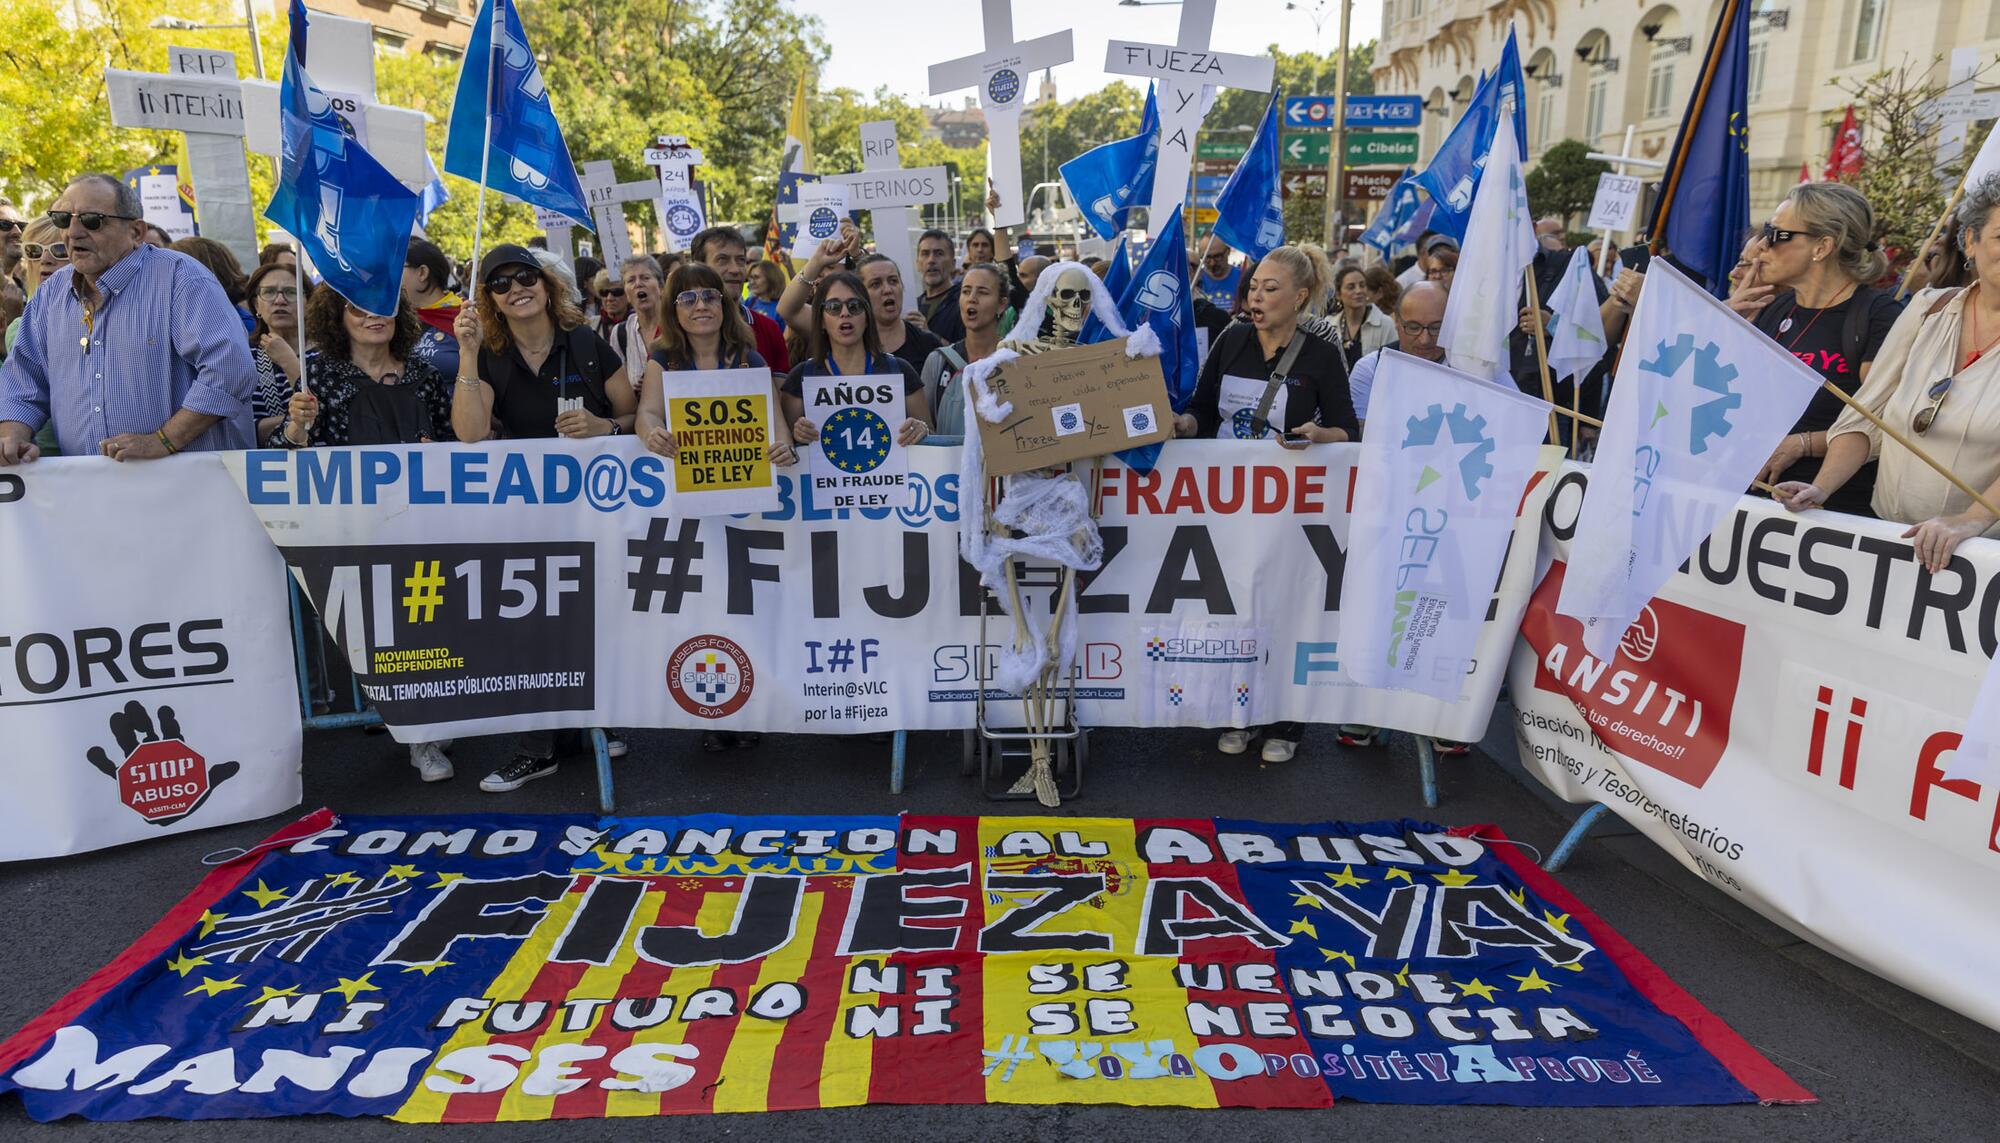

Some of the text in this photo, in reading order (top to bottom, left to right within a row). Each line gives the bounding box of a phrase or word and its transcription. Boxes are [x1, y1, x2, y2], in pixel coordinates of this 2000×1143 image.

[178, 54, 227, 75] RIP
[1124, 47, 1224, 75] FIJEZA
[650, 151, 692, 160] CESADA
[865, 139, 895, 158] RIP
[1350, 142, 1414, 154] de Cibeles
[665, 170, 684, 181] 24
[1350, 175, 1392, 186] Palacio
[850, 177, 936, 200] TERINOS
[814, 382, 894, 406] AÑOS
[684, 399, 758, 427] S.O.S.
[677, 426, 765, 448] INTERINOS
[839, 426, 875, 450] 14
[680, 447, 762, 466] EN FRAUDE
[245, 450, 666, 512] EMPLEAD@S
[1097, 465, 1327, 516] FRAUDE
[692, 464, 754, 485] DE LEY
[816, 474, 904, 489] EN FRAUDE
[834, 494, 889, 507] DE LEY
[374, 647, 450, 662] MOVIMIENTO
[1166, 638, 1257, 656] SPPLB
[374, 656, 465, 674] INDEPENDIENTE
[671, 638, 751, 694] BOMBERS FORESTALS
[393, 680, 457, 700] TEMPORALES
[458, 674, 503, 695] PÚBLICOS
[504, 677, 516, 691] EN
[518, 674, 554, 690] FRAUDE
[555, 672, 568, 688] DE
[569, 671, 586, 687] LEY
[684, 671, 737, 685] SPPLB
[803, 680, 888, 698] Interin@sVLC
[930, 691, 973, 700] Sindicato
[1098, 689, 1123, 698] Local
[1544, 641, 1702, 738] ANSITI
[698, 706, 724, 717] GVA
[804, 704, 888, 722] por la #Fijeza
[1588, 708, 1609, 728] tus
[1610, 718, 1686, 760] derechos!!
[129, 757, 194, 785] STOP
[131, 782, 199, 805] ABUSO
[289, 825, 1486, 867] COMO SANCION AL ABUSO
[190, 862, 1597, 969] #FIJEZA YA
[240, 993, 386, 1033] MI
[433, 982, 807, 1033] FUTURO
[851, 960, 957, 995] NI
[1028, 960, 1130, 994] SE
[849, 998, 1598, 1041] NI SE NEGOCIA
[11, 1025, 699, 1098] MANISES
